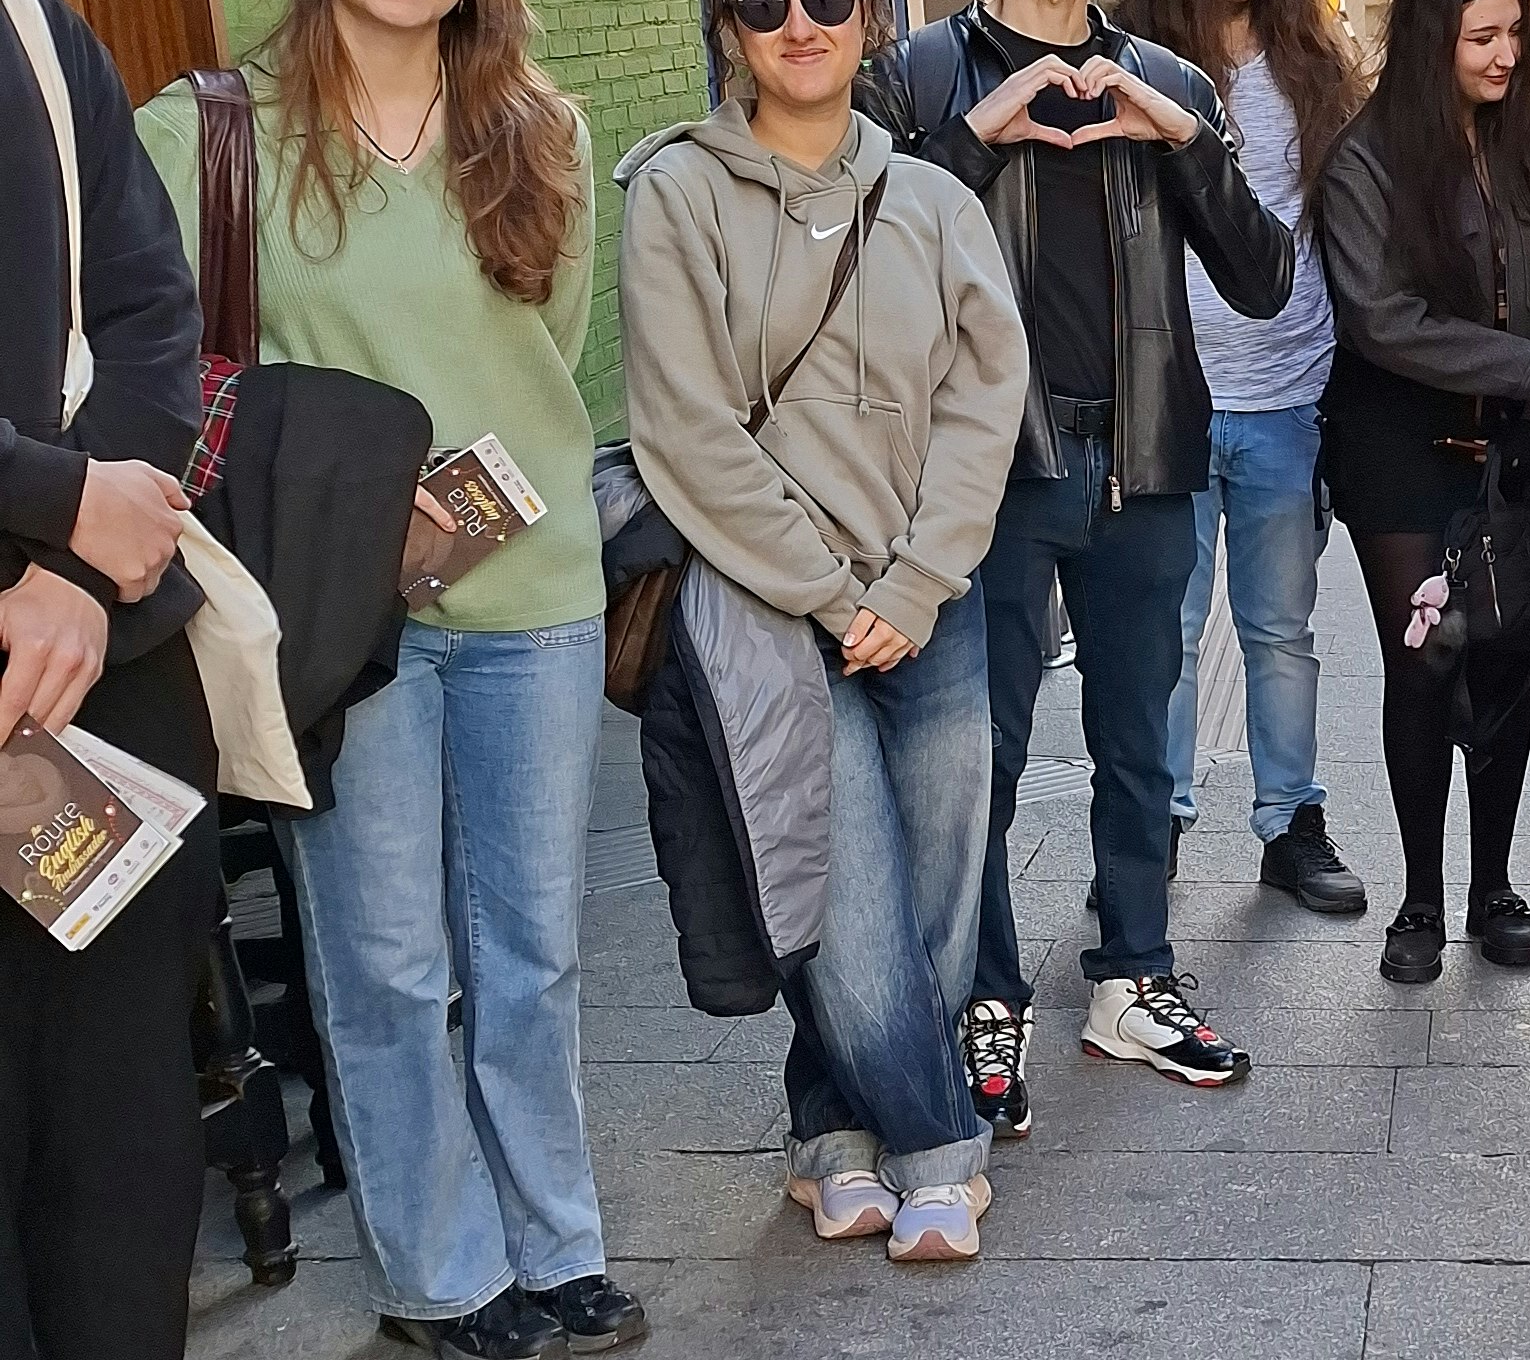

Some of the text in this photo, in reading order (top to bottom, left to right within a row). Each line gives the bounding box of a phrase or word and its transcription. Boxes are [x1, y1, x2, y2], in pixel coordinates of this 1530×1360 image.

[447, 488, 488, 537] Ruta
[18, 802, 83, 866] Route
[39, 815, 96, 879] English
